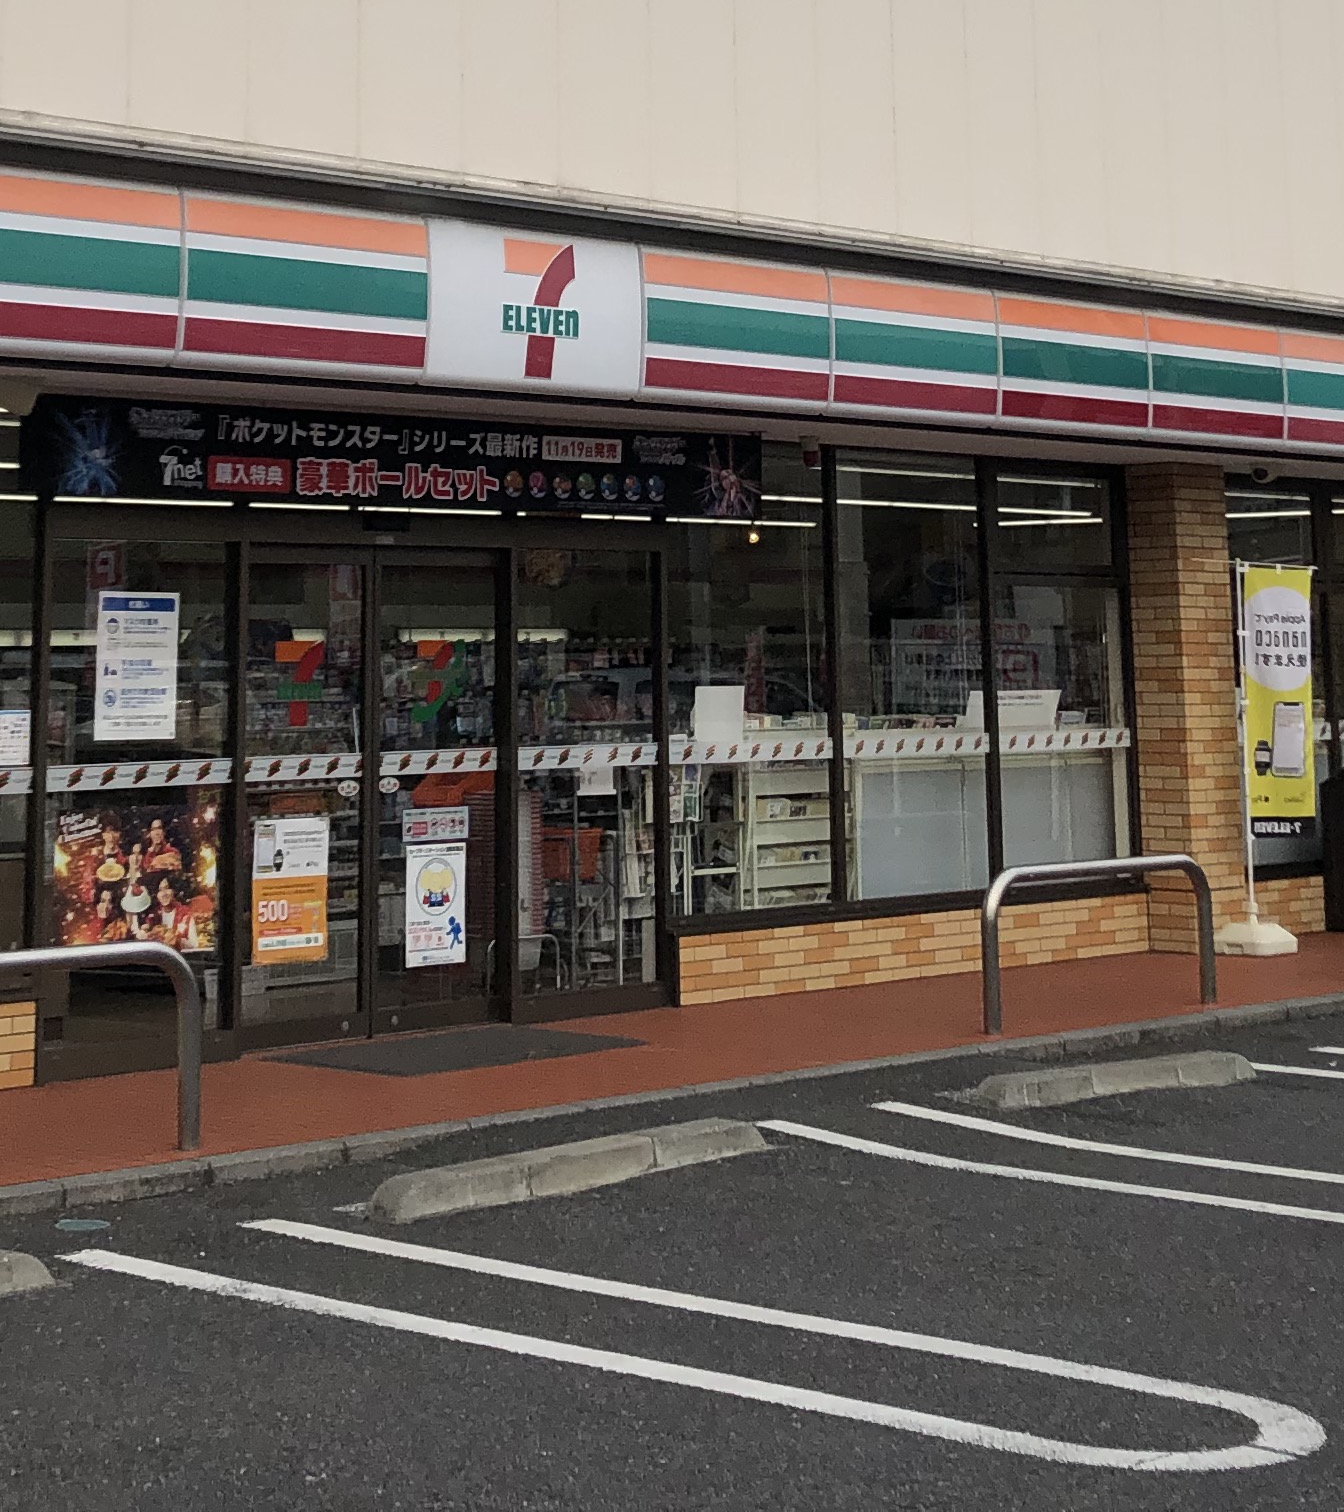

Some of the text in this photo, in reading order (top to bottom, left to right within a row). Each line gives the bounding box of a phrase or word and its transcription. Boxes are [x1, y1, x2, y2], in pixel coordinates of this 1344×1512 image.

[218, 414, 538, 458] 『ポケットモンスター』シリーズ最新作
[545, 440, 618, 459] 11月19日発売
[215, 463, 283, 486] 購入特典
[296, 457, 499, 501] 豪華ボールセット
[258, 899, 289, 923] 500
